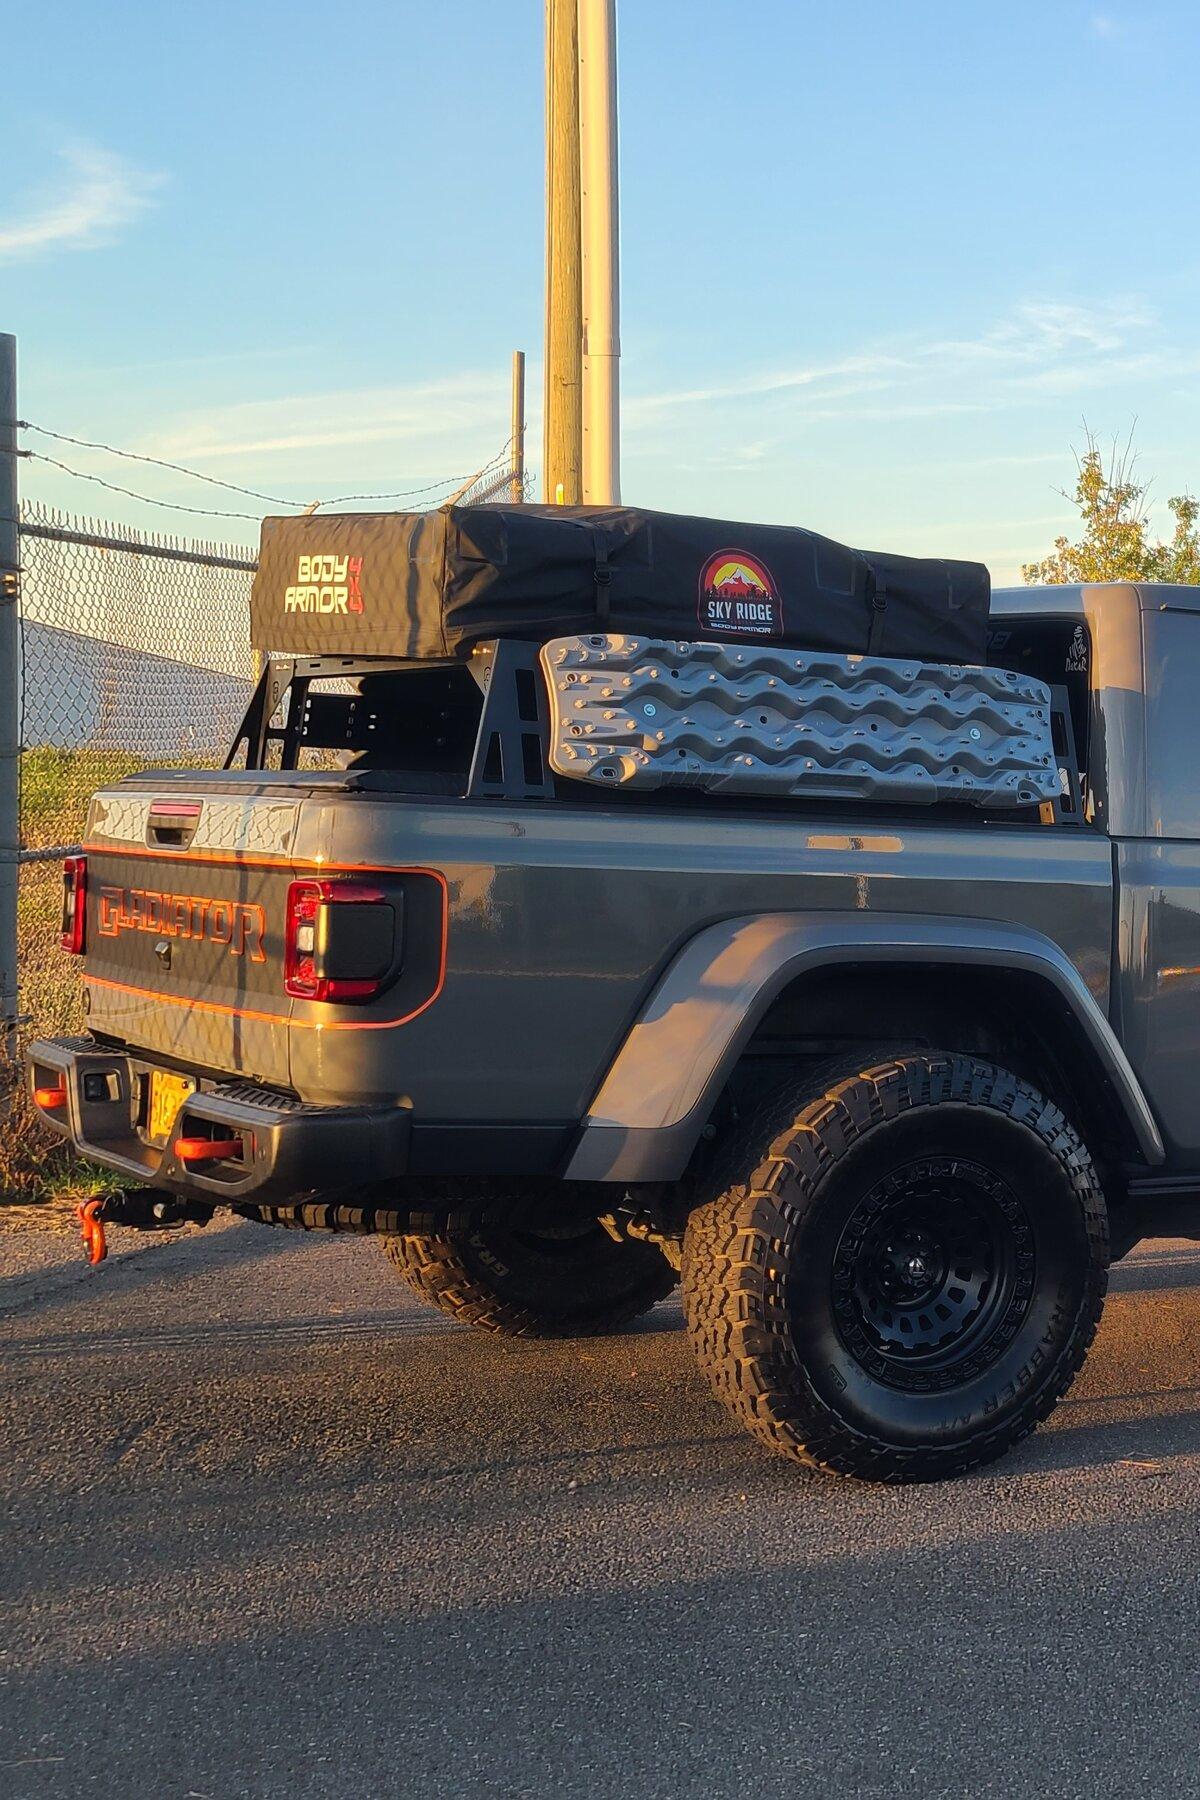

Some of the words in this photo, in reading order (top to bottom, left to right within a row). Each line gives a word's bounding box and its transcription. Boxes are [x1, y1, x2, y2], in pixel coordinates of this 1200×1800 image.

[298, 555, 349, 582] BODY
[284, 586, 349, 614] ARMOR
[707, 601, 732, 619] SKY
[736, 602, 773, 621] RIDGE
[738, 626, 772, 634] ARMOR
[98, 886, 267, 964] GLADIATOR
